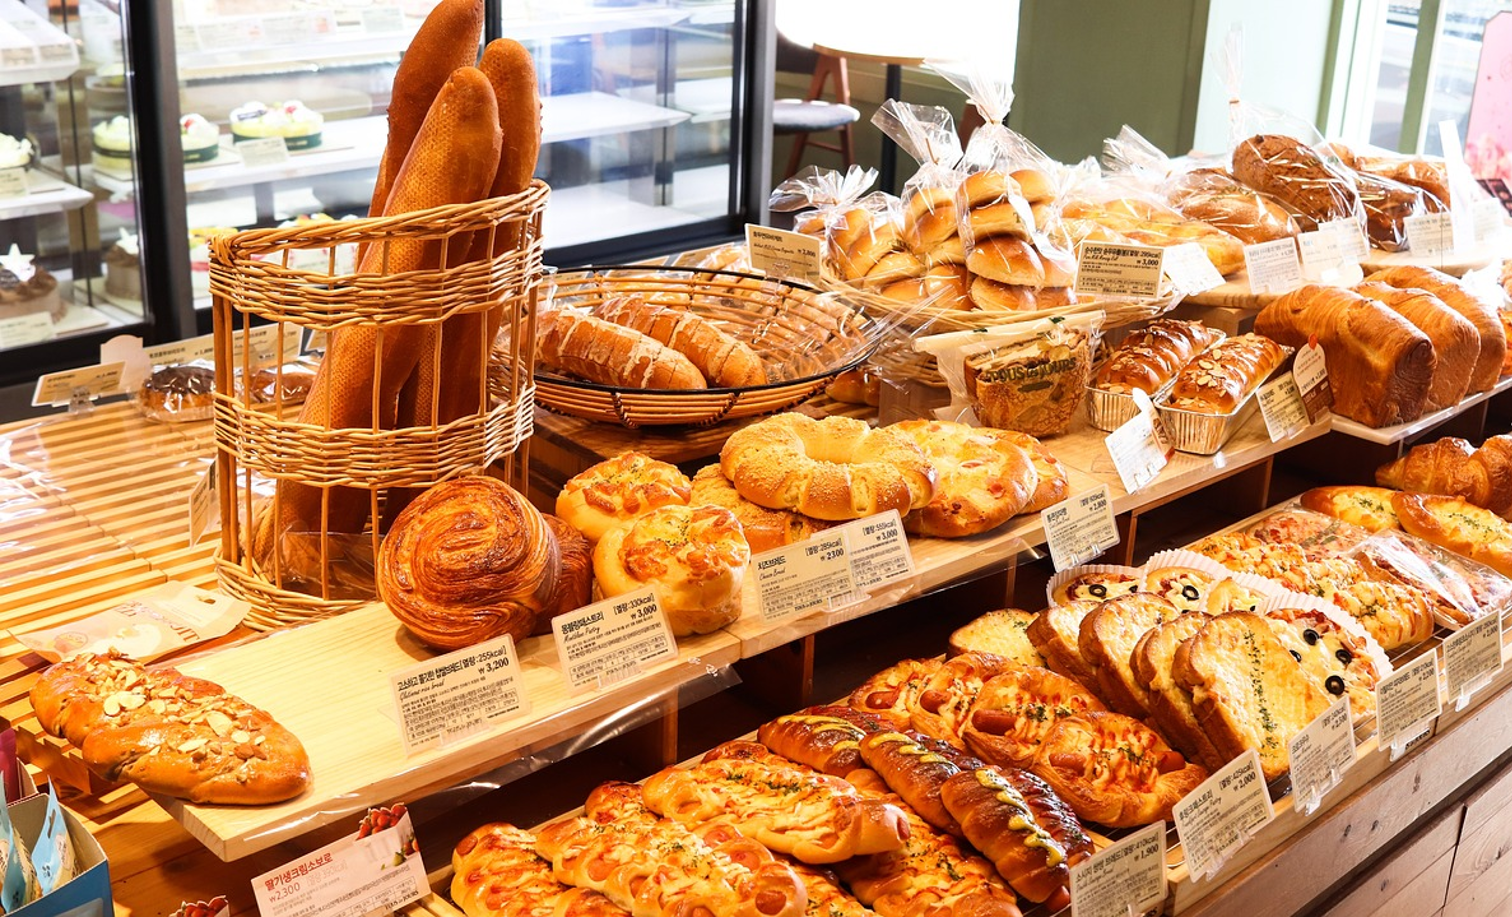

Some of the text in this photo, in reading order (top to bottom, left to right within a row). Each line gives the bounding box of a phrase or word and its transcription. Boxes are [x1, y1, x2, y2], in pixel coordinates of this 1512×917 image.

[638, 604, 657, 619] 3,000
[486, 657, 509, 674] 3,200
[264, 852, 334, 892] 딸기생크림소보로
